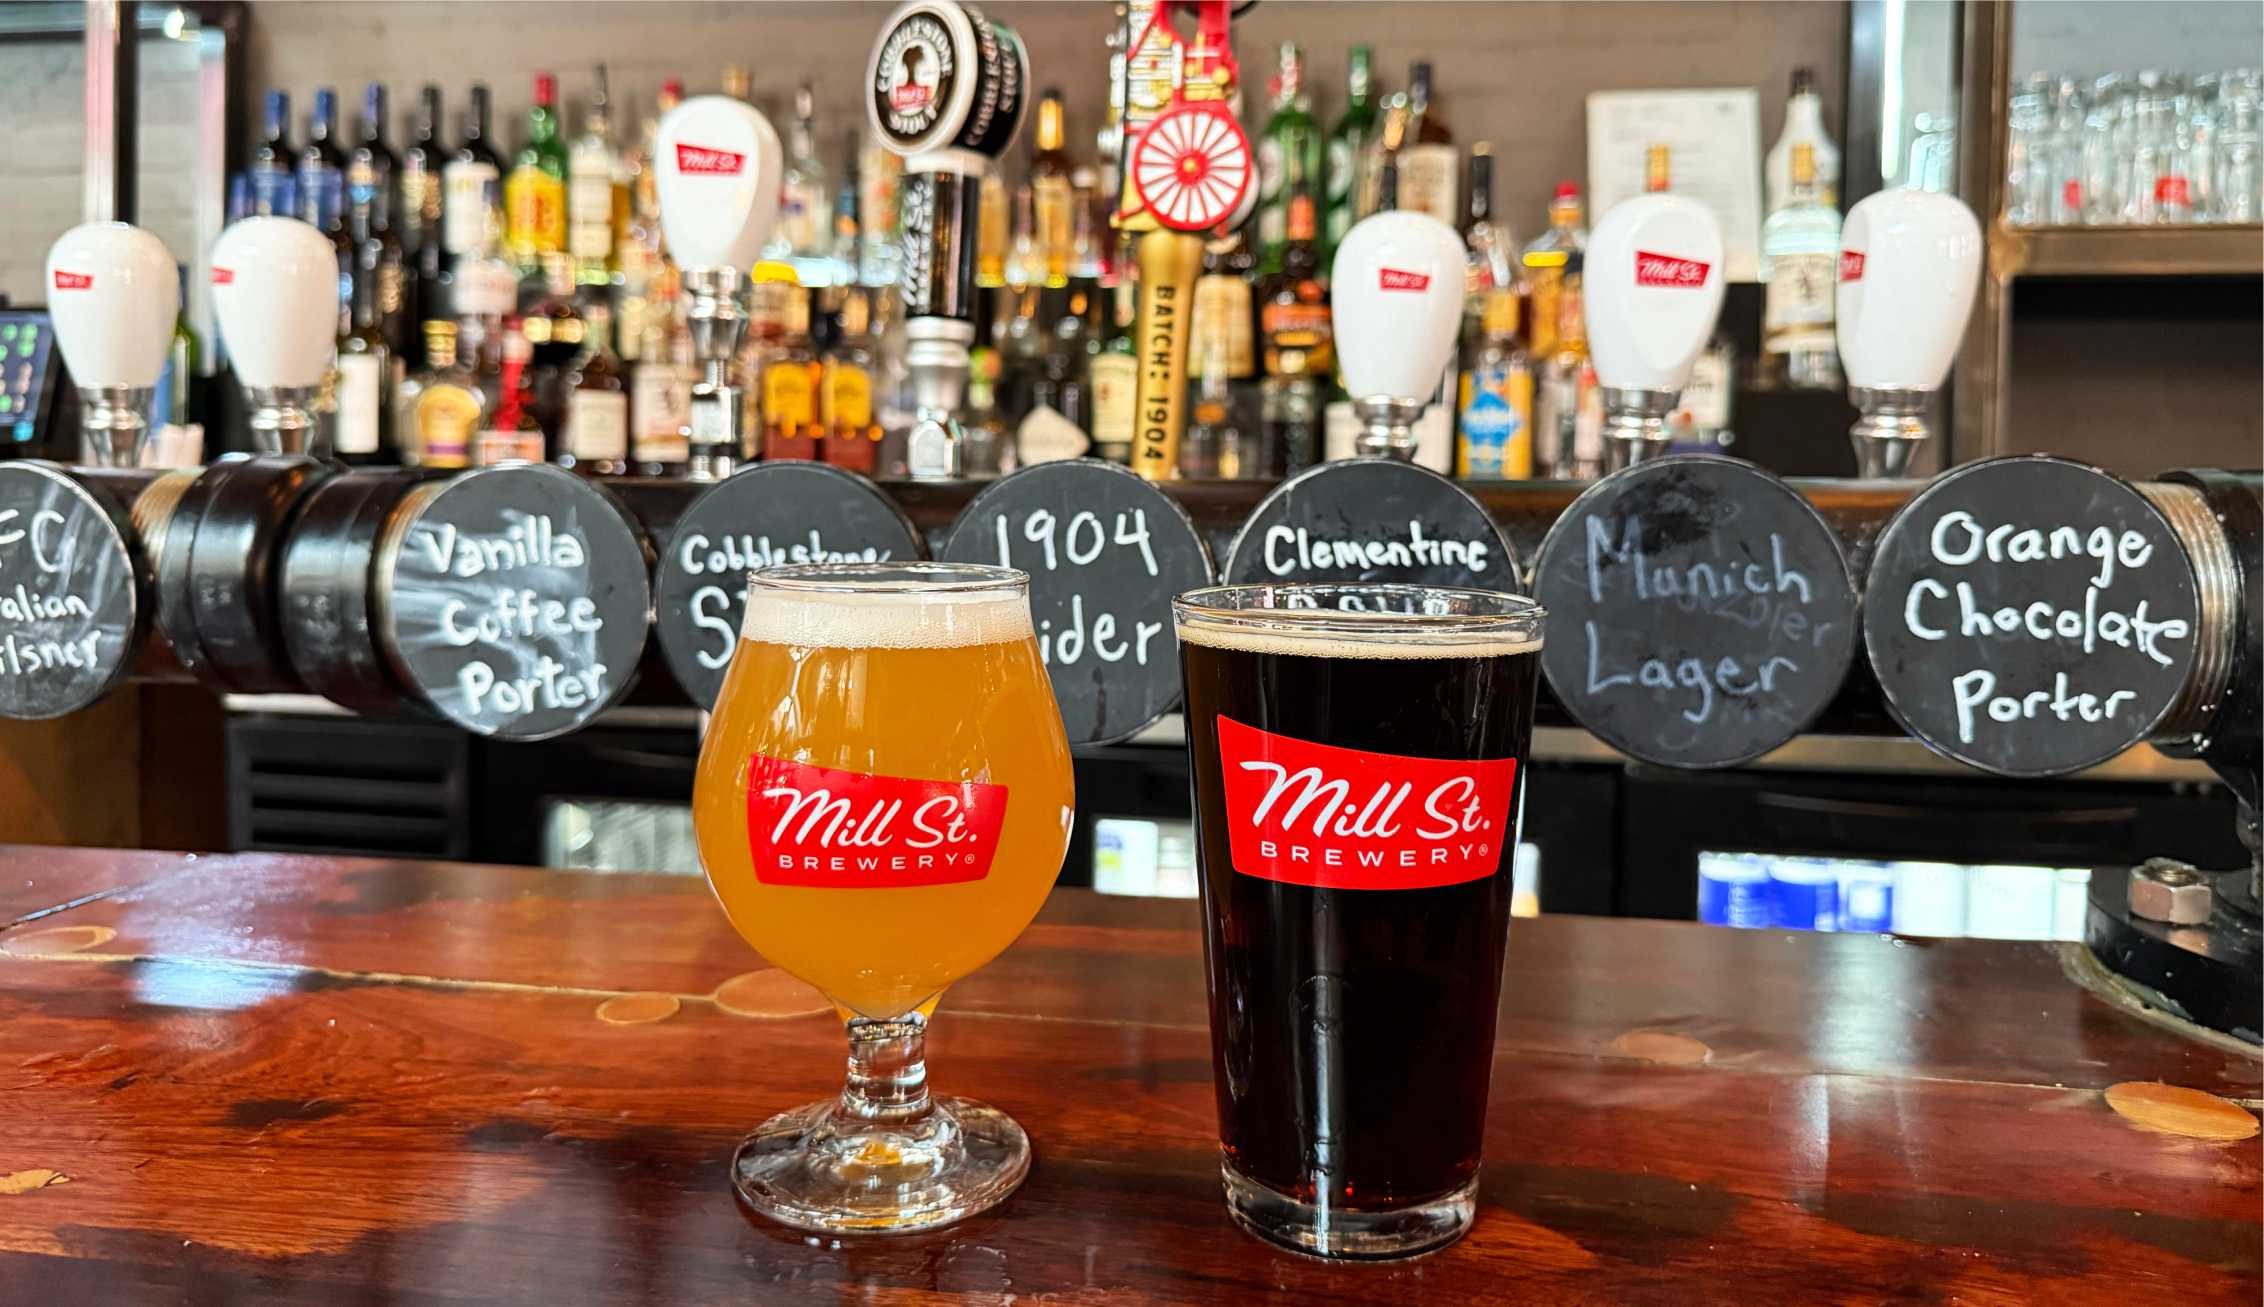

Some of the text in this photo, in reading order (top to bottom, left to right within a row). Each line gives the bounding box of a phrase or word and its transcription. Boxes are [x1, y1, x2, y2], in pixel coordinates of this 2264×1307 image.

[1144, 285, 1176, 460] BATCH: 1904
[412, 514, 585, 578] Vanilla
[996, 508, 1159, 577] 1904
[1264, 520, 1489, 576] Clementine
[1585, 514, 1812, 604] Munich
[1930, 510, 2154, 589] Orange
[0, 583, 94, 623] alian
[440, 587, 603, 647] Coffee
[1040, 594, 1163, 666] ider
[1904, 577, 2190, 666] Chocolate
[457, 655, 608, 715] Porter
[1585, 620, 1799, 723] Lager
[1952, 669, 2138, 744] Porter
[762, 787, 978, 849] Mill St.
[1239, 760, 1491, 840] Mill St.
